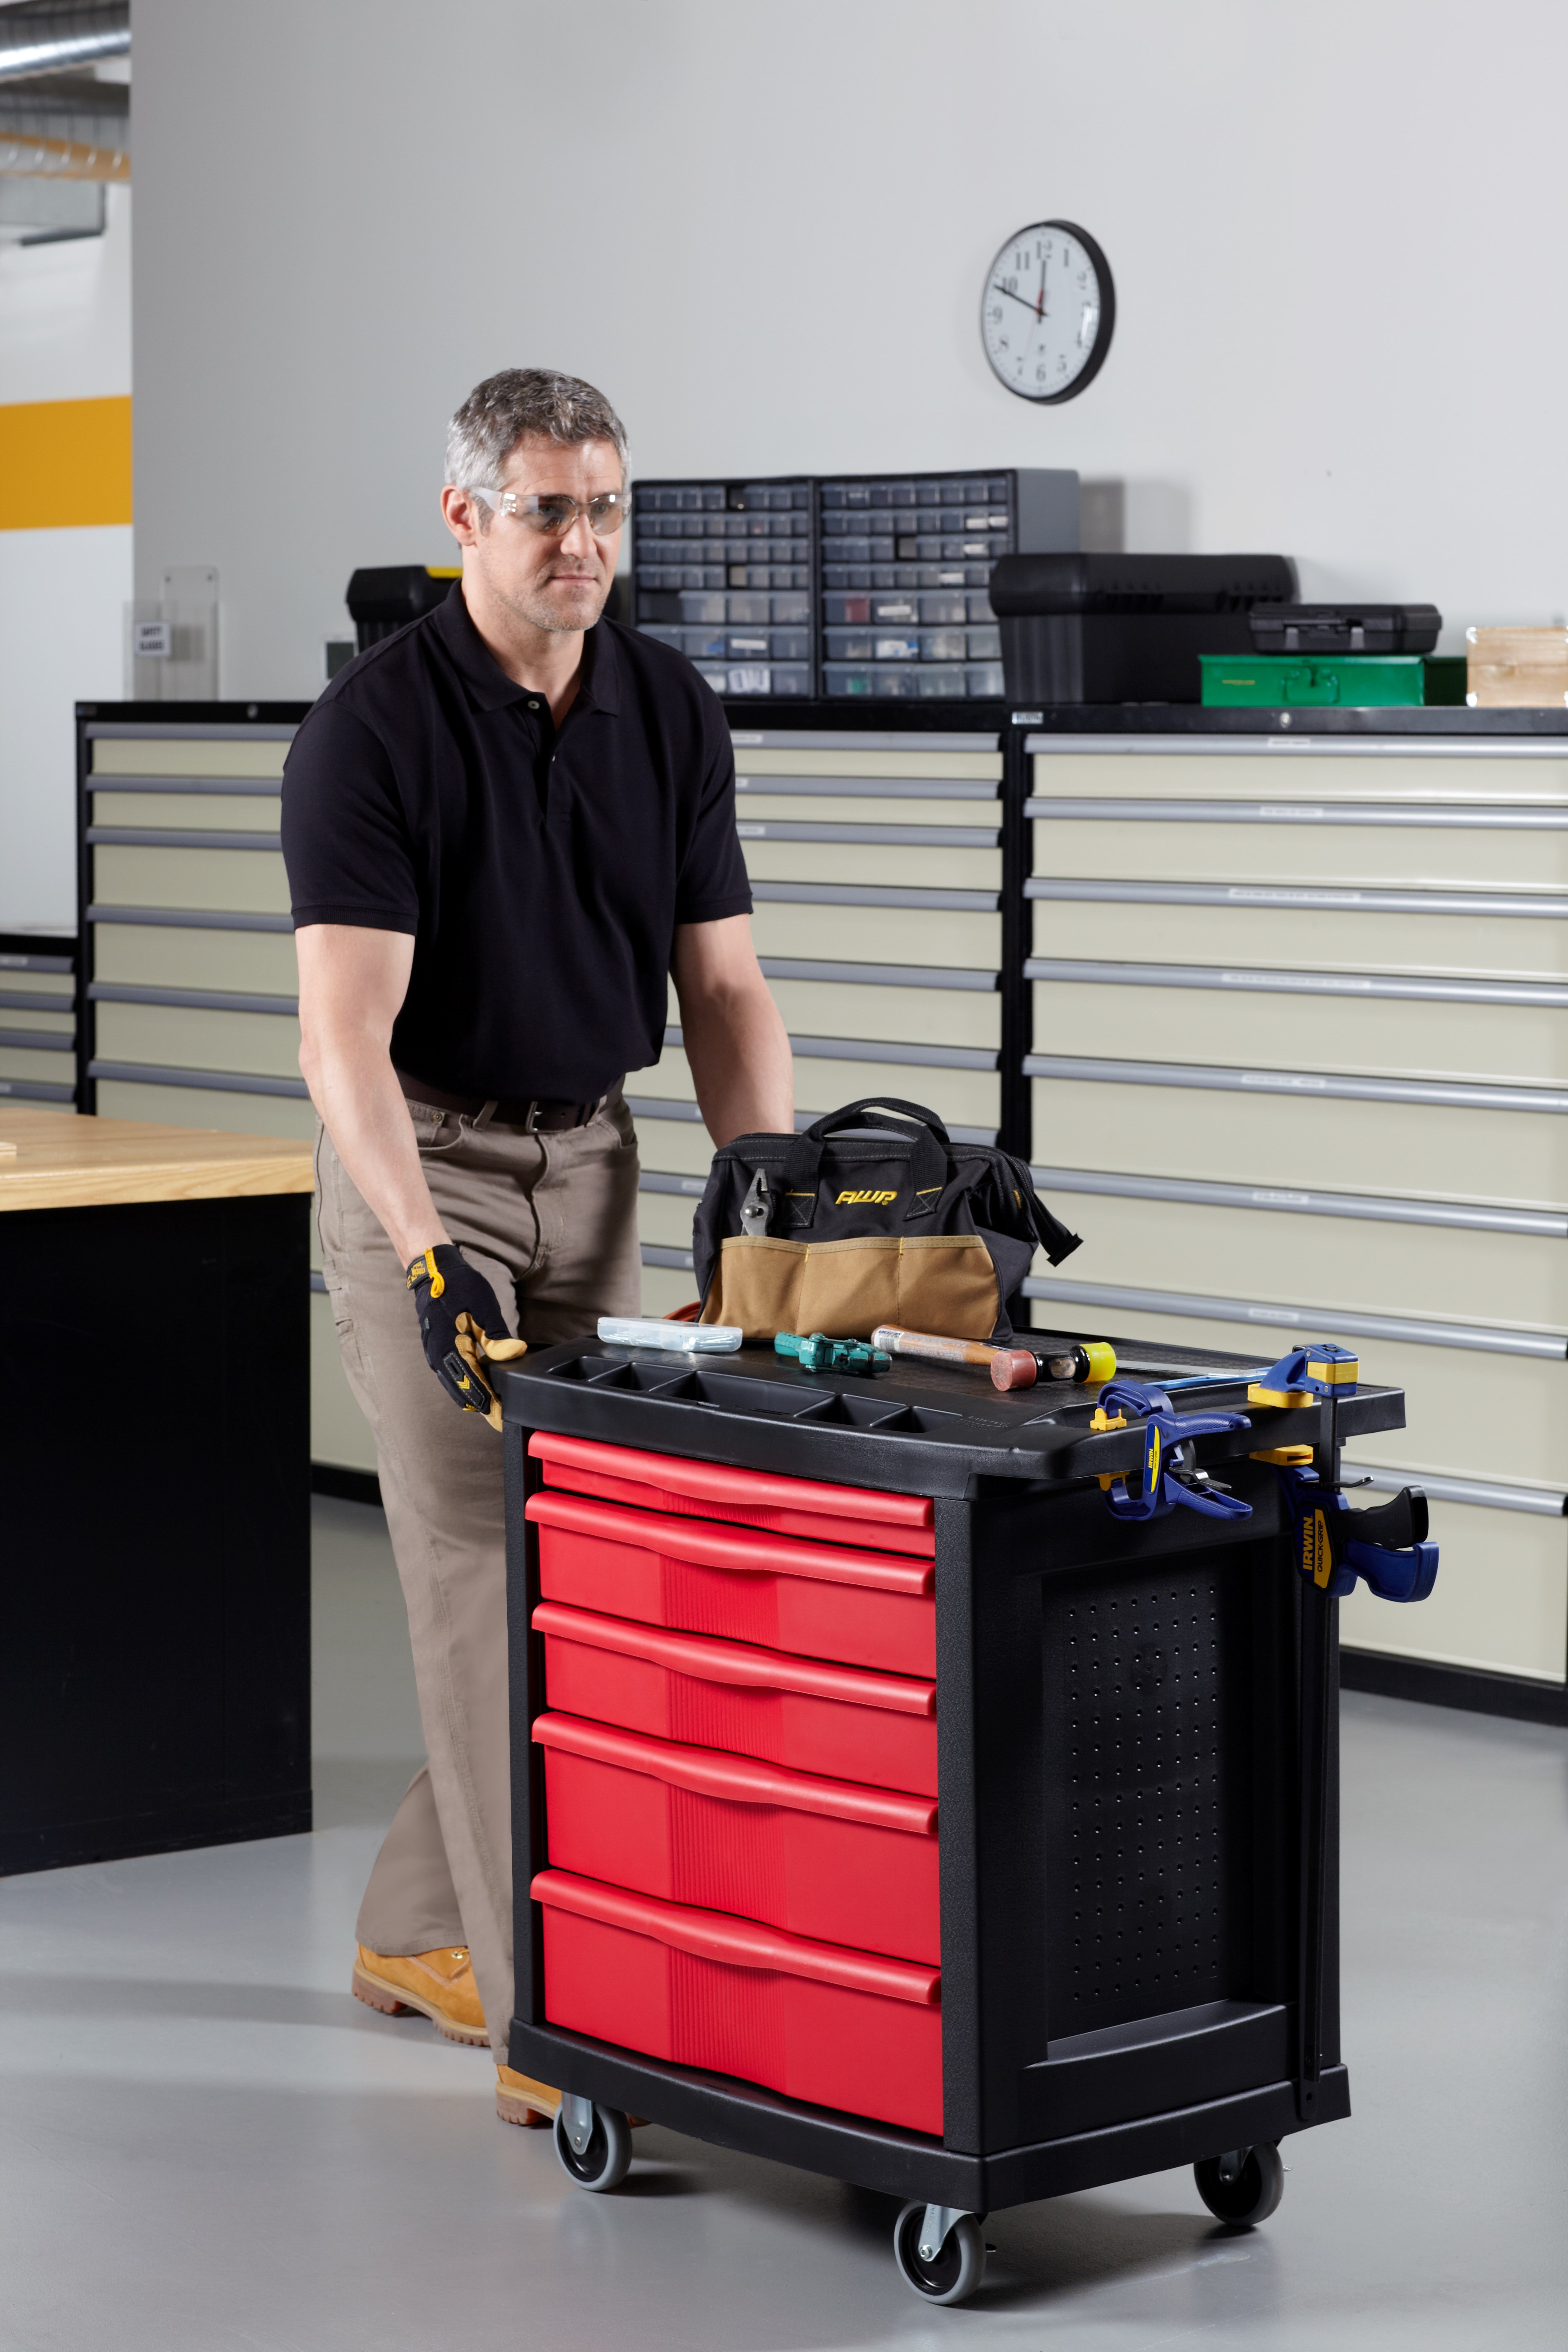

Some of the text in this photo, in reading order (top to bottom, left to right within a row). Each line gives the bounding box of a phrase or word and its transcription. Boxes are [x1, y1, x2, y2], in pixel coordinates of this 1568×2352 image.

[1037, 240, 1052, 260] 12
[1064, 248, 1068, 267] 1
[1016, 252, 1030, 270] 11
[1002, 276, 1018, 294] 10
[1077, 271, 1087, 290] 2
[993, 306, 1003, 324] 9
[998, 334, 1009, 353] 8
[1015, 356, 1024, 377] 7
[1057, 353, 1067, 372] 5
[1036, 363, 1047, 382] 6
[835, 1190, 898, 1205] AWP
[1303, 1516, 1313, 1570] IRWIN
